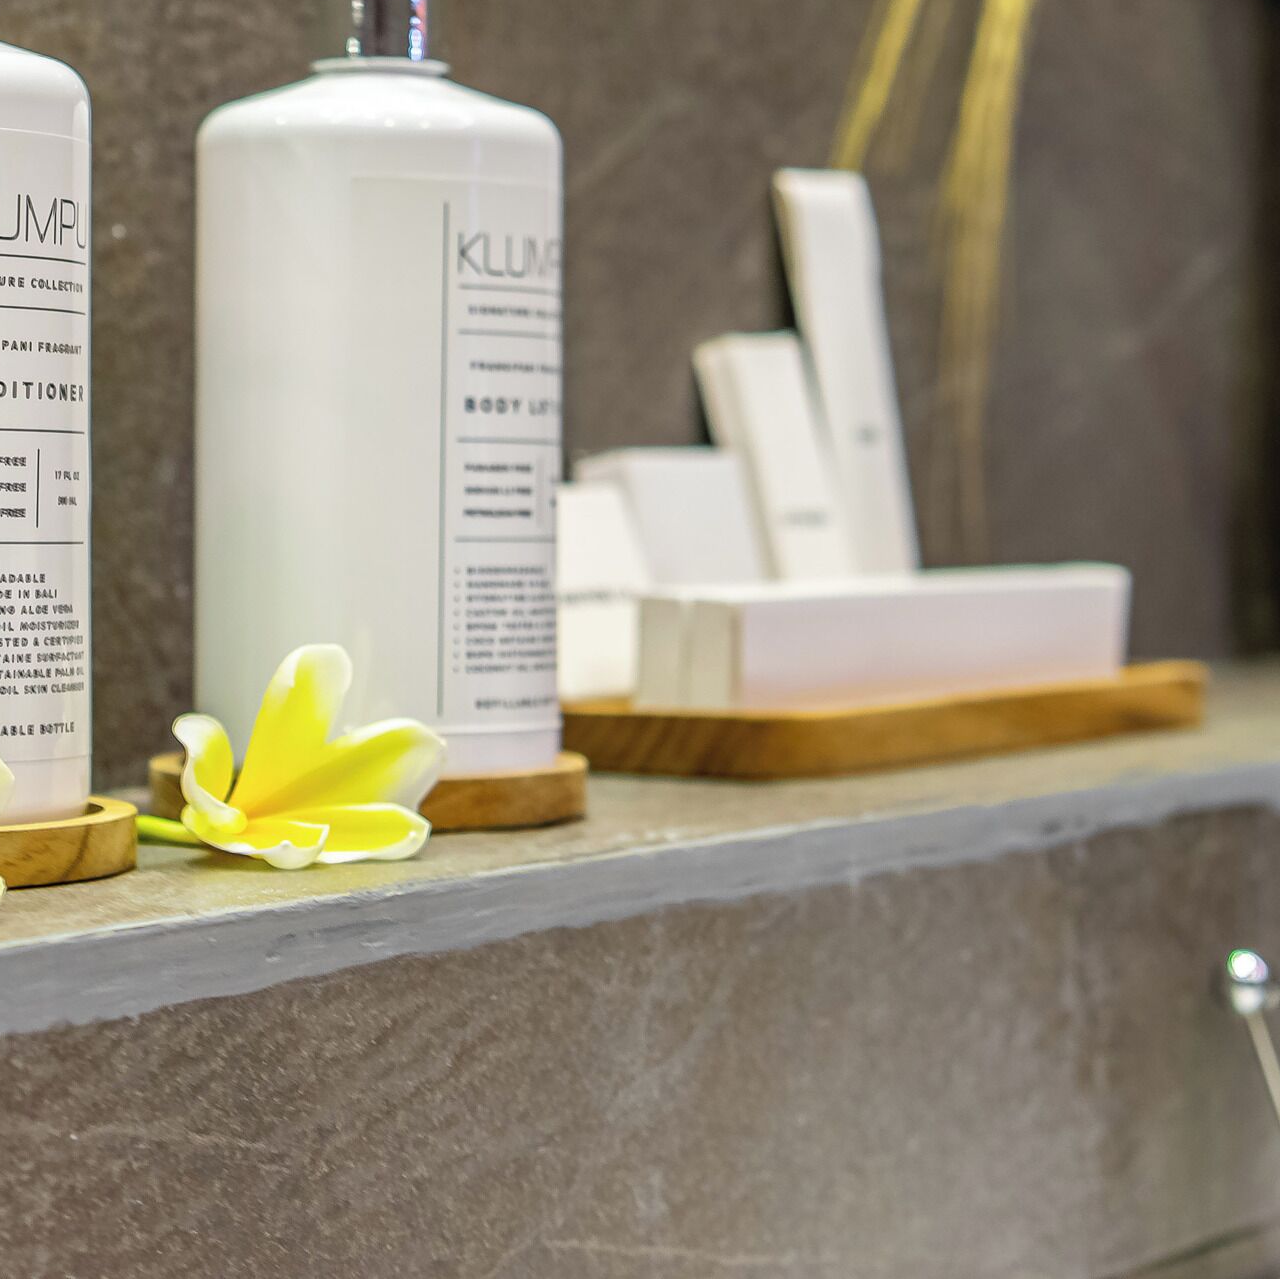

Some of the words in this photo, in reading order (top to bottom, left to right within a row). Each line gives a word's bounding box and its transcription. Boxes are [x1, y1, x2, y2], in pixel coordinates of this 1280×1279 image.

[30, 277, 83, 293] COLLECTION
[0, 507, 27, 518] FREE
[18, 589, 30, 600] IN
[34, 588, 58, 600] BALI
[20, 604, 49, 616] ALOE
[0, 684, 19, 696] OIL
[23, 683, 48, 695] SKIN
[39, 721, 76, 735] BOTTLE
